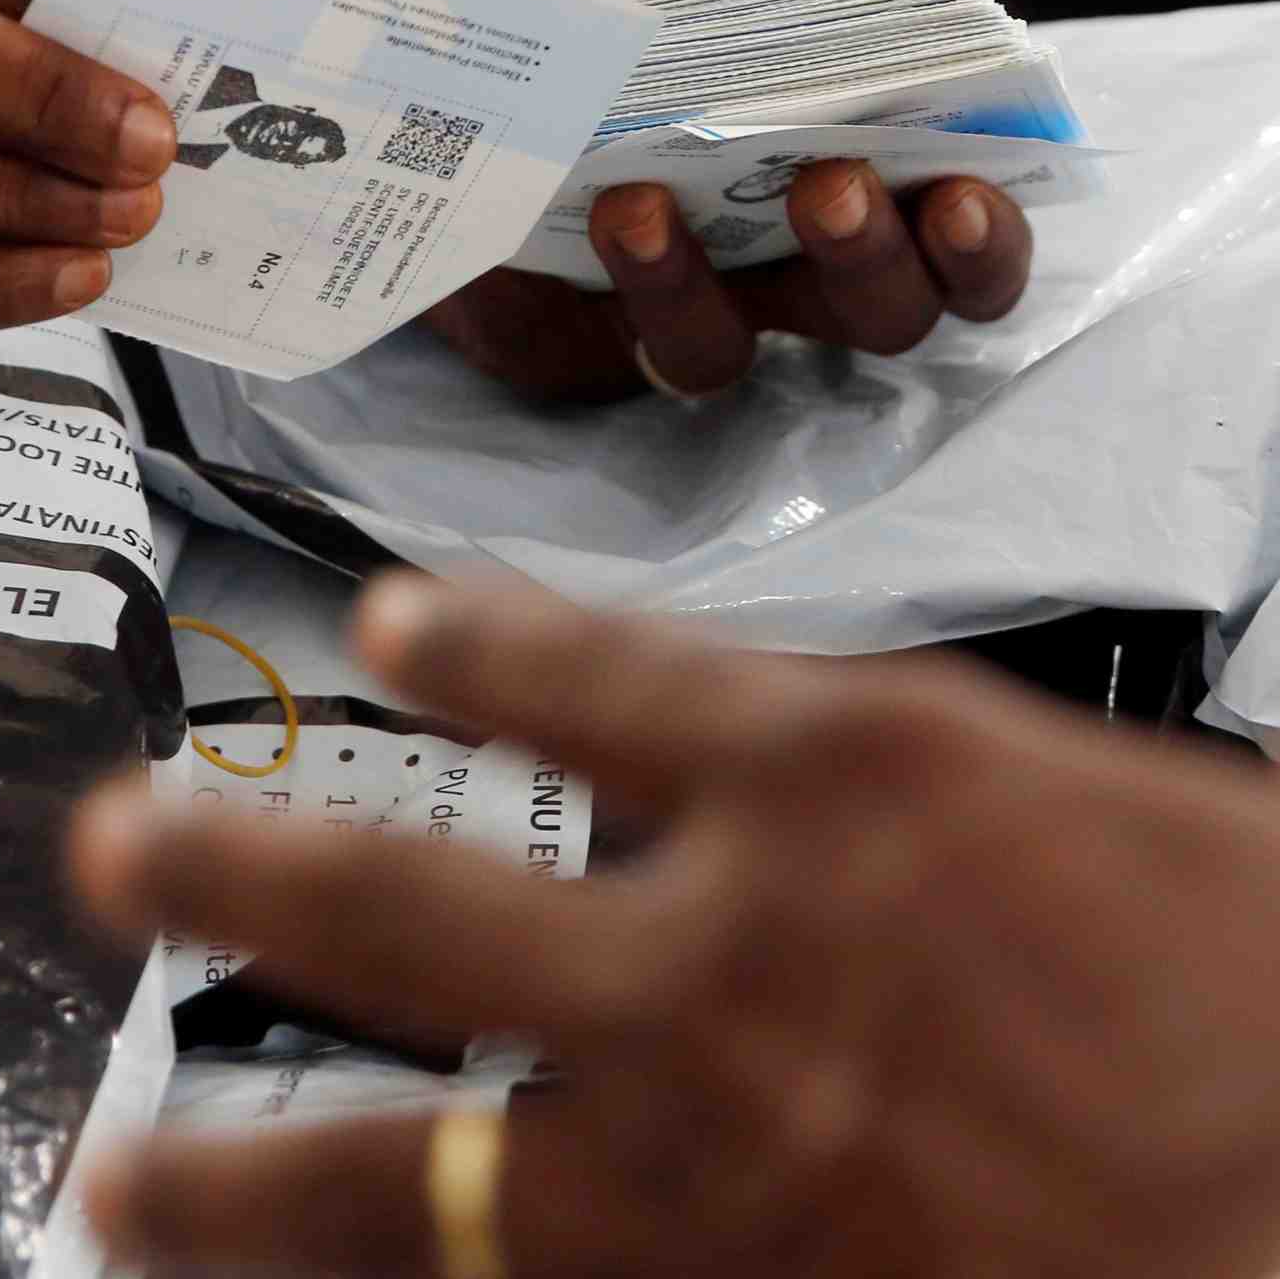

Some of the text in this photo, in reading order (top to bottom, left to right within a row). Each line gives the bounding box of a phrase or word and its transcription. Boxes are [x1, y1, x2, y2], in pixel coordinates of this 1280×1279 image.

[418, 197, 449, 234] Election
[248, 251, 283, 292] No.4
[434, 766, 470, 801] PV
